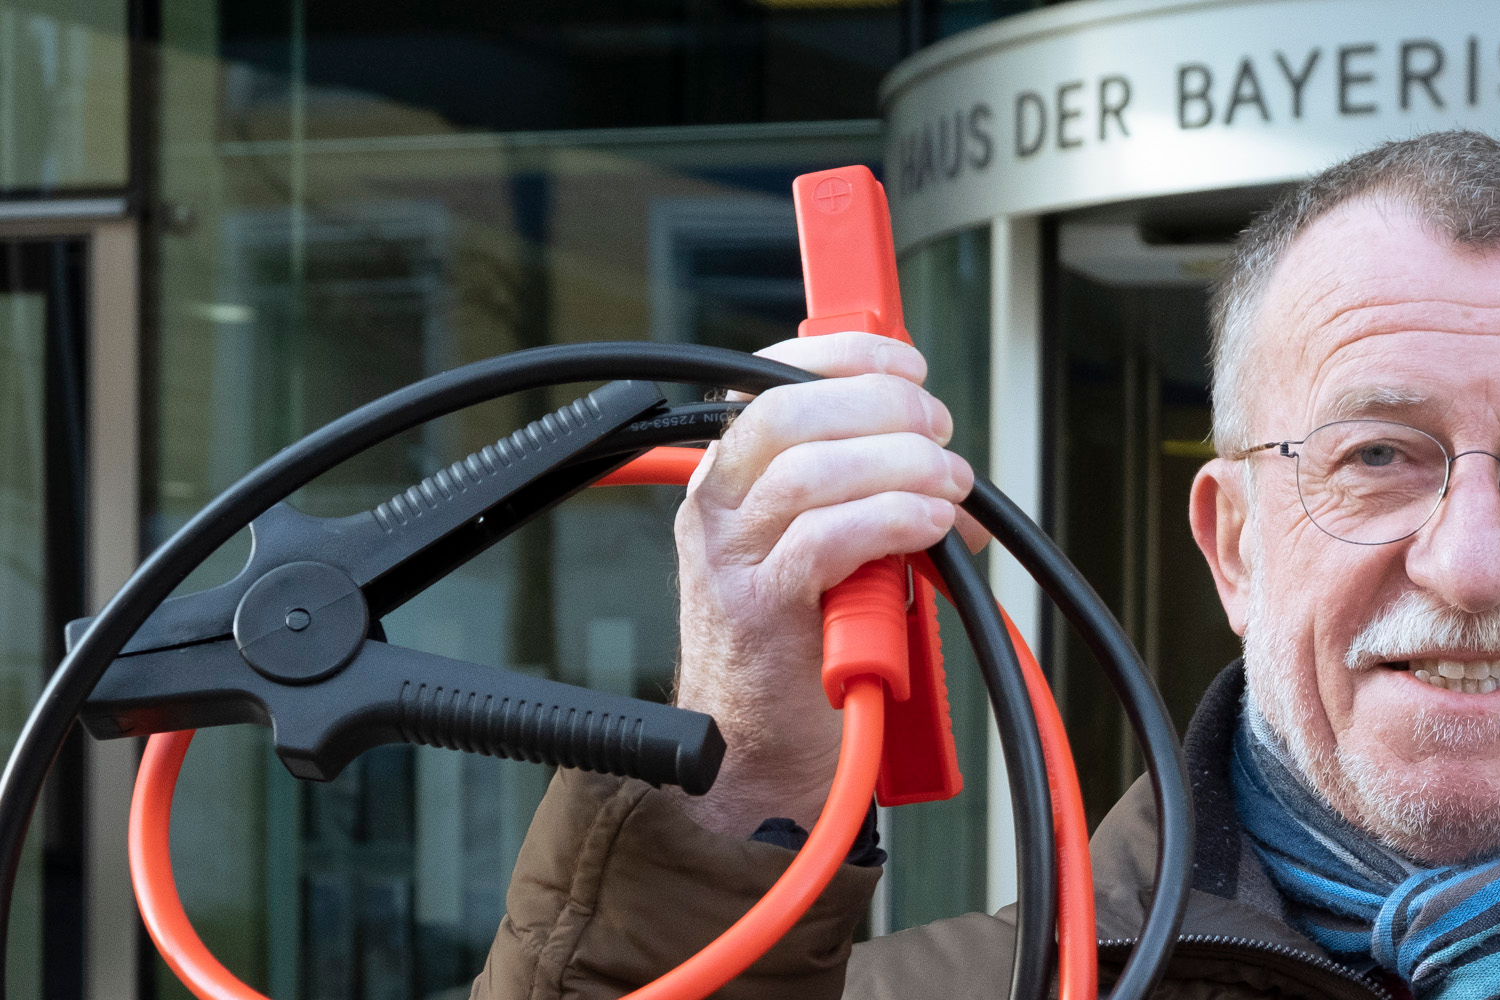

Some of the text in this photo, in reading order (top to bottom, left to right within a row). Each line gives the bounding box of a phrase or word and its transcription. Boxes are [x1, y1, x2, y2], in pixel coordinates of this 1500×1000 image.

[898, 101, 995, 196] HAUS
[1012, 72, 1135, 160] DER
[631, 414, 696, 432] 72553-25
